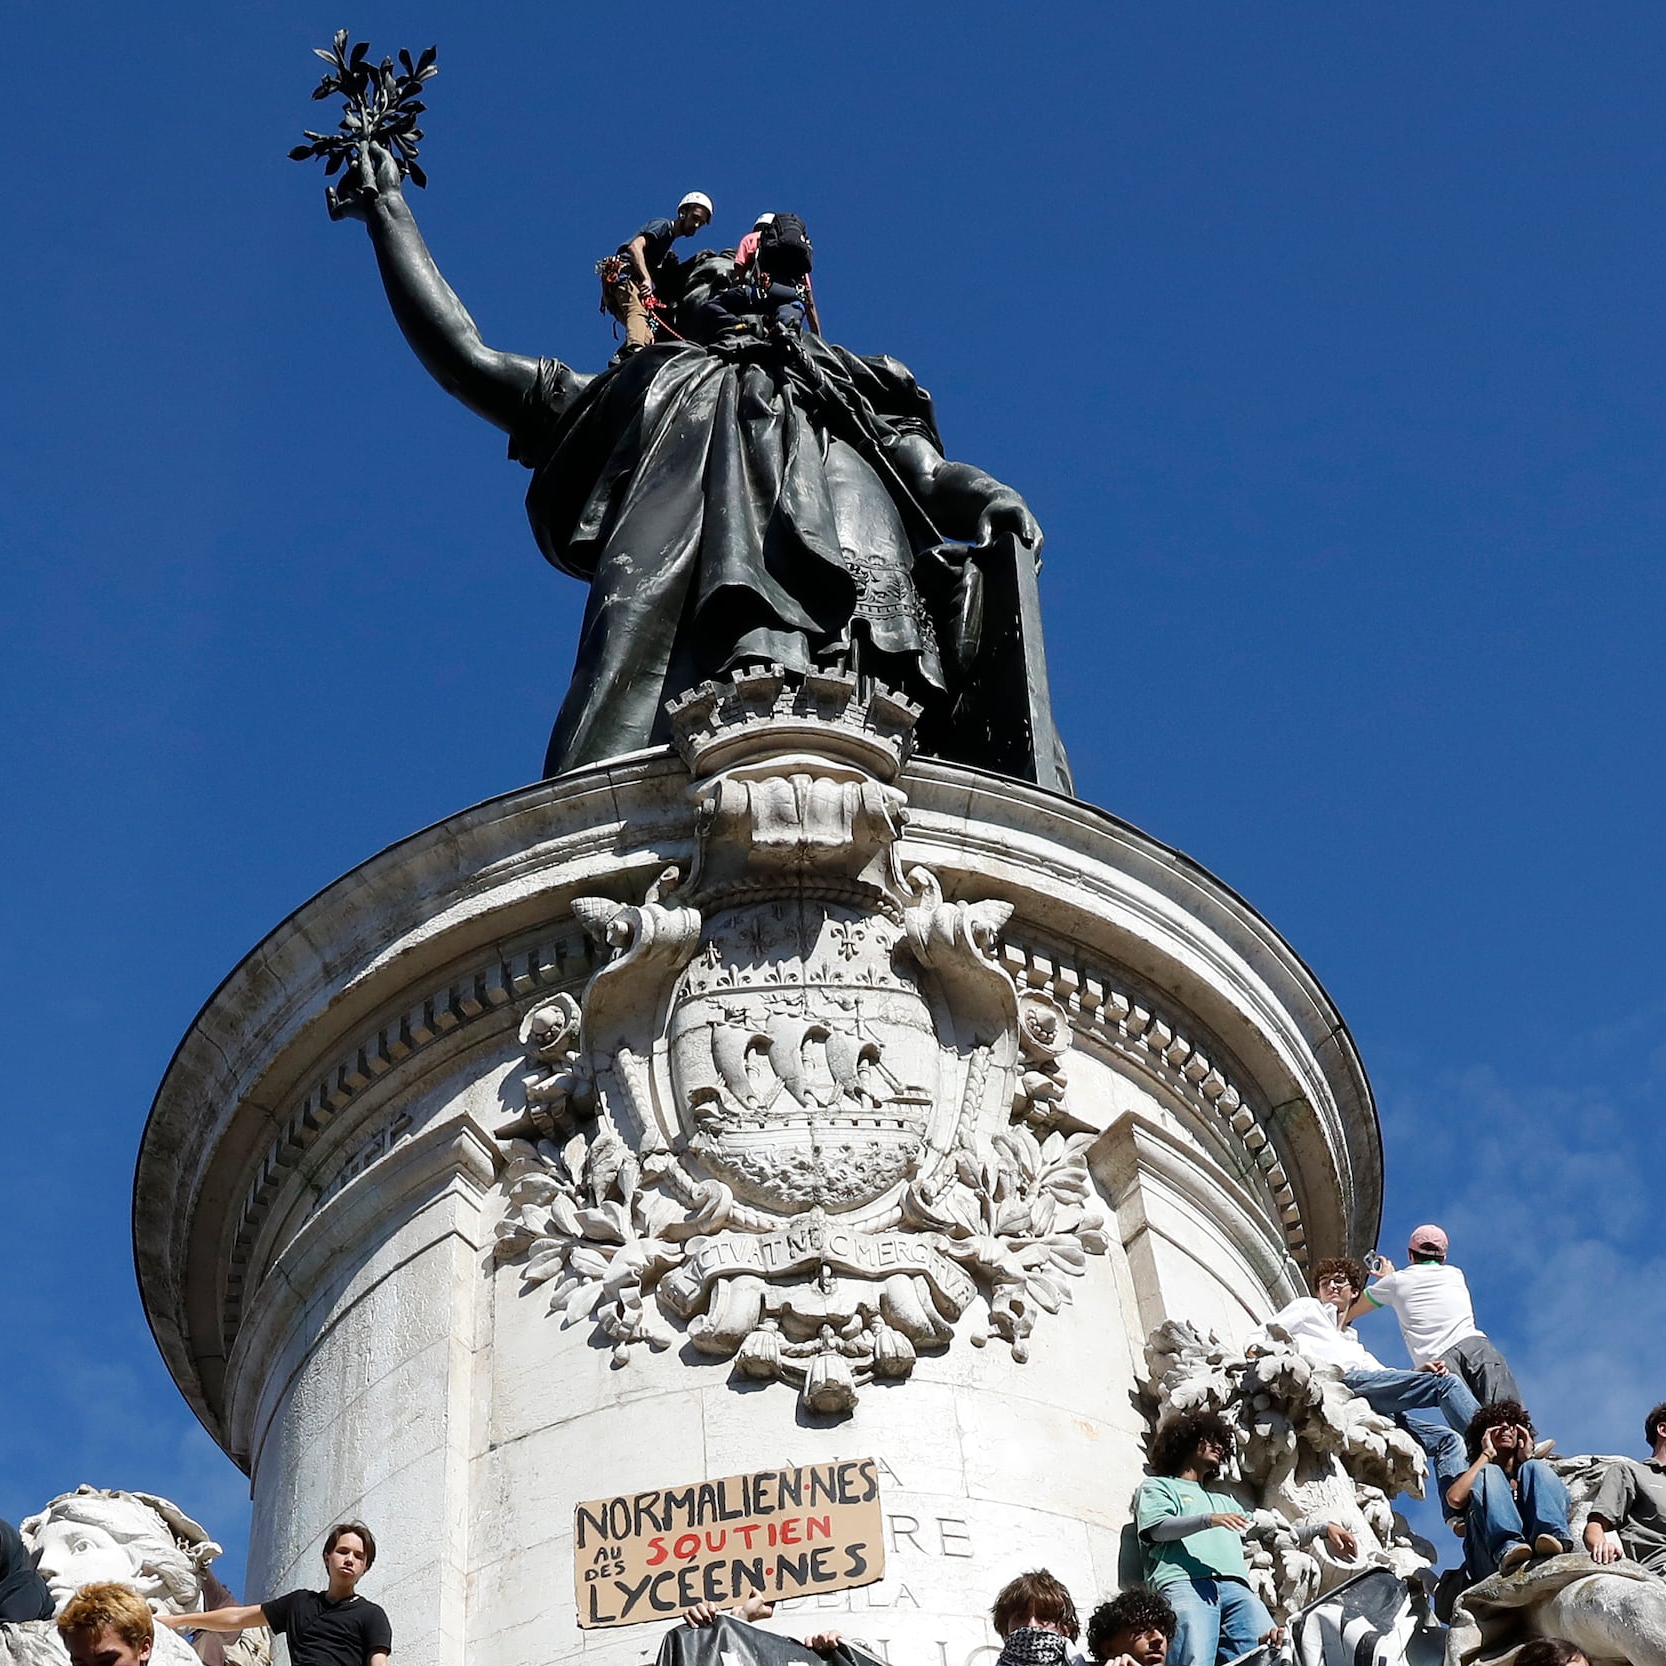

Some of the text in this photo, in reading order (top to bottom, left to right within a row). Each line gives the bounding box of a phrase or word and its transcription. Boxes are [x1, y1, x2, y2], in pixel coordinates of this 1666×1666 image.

[594, 1515, 832, 1567] AU SOUTIEN
[584, 1560, 626, 1583] DES
